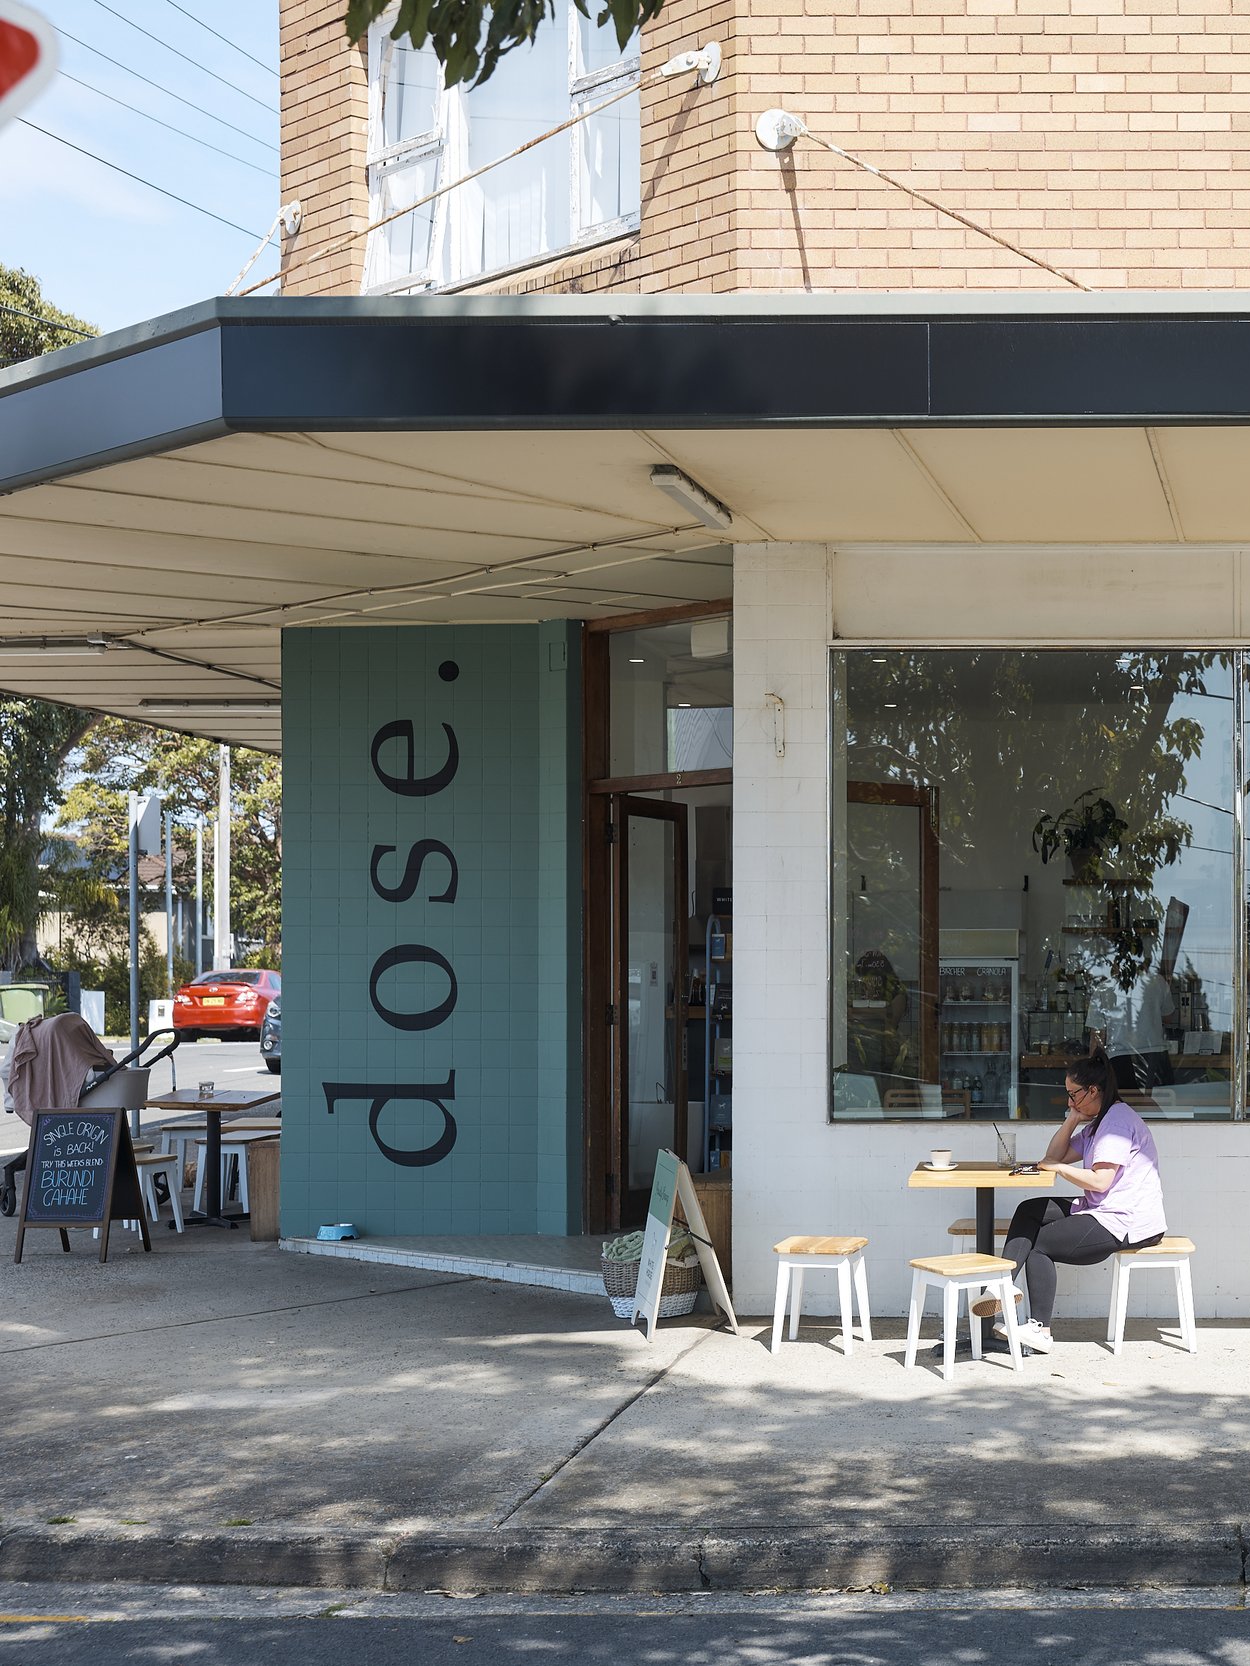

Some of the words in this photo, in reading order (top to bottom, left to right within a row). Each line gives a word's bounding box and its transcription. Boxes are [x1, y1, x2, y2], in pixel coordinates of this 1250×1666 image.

[321, 660, 460, 1168] dose.
[43, 1121, 74, 1146] SINGLE
[76, 1121, 109, 1145] ORIGIN
[66, 1141, 94, 1155] BACK!
[41, 1160, 53, 1168] TRY
[55, 1160, 66, 1168] THIS
[85, 1158, 104, 1167] BLEND
[40, 1169, 95, 1189] BURUNDI
